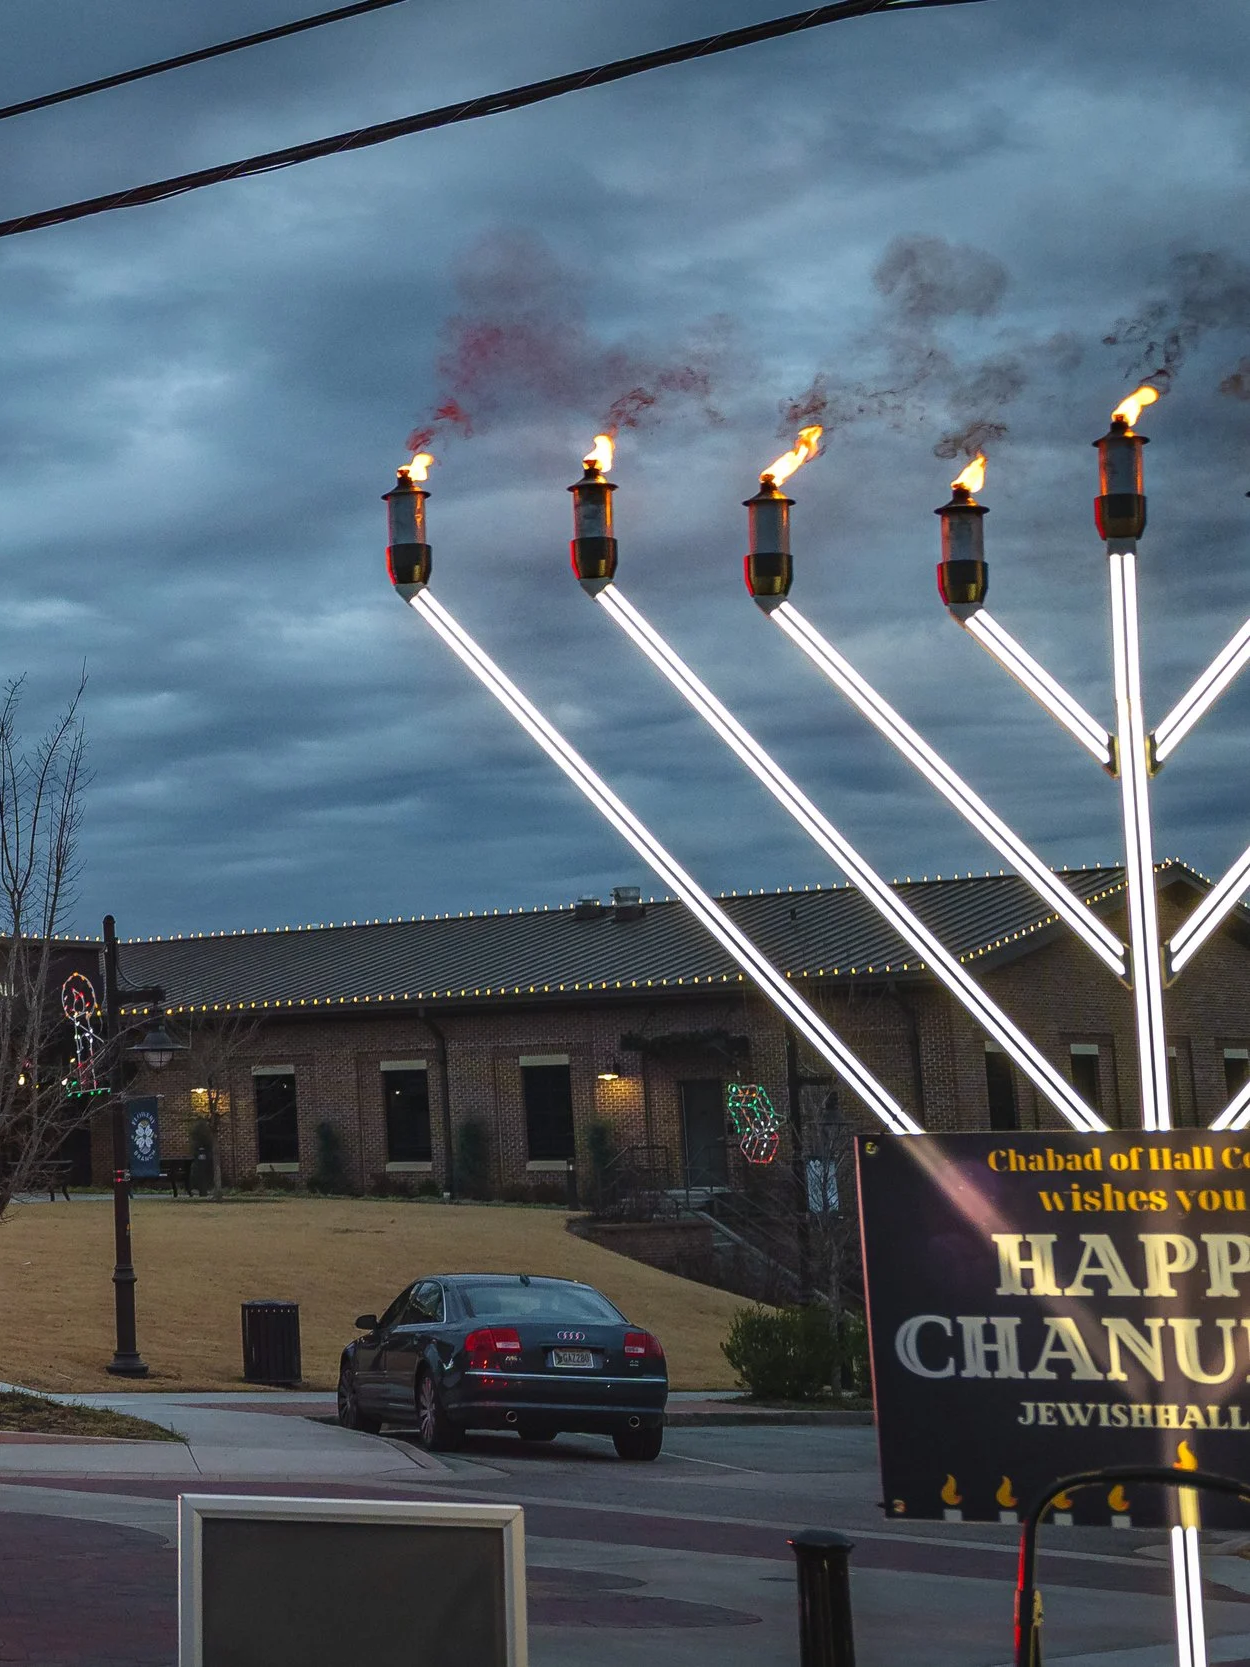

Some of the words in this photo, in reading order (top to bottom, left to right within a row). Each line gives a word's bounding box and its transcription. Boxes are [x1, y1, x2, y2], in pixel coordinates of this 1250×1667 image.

[987, 1147, 1103, 1172] Chabad
[1109, 1147, 1144, 1171] of
[1149, 1146, 1214, 1171] Hall
[1038, 1183, 1169, 1212] wishes
[1175, 1190, 1247, 1214] you
[894, 1314, 1250, 1384] CHANU
[1018, 1402, 1250, 1430] JEWISHHALL
